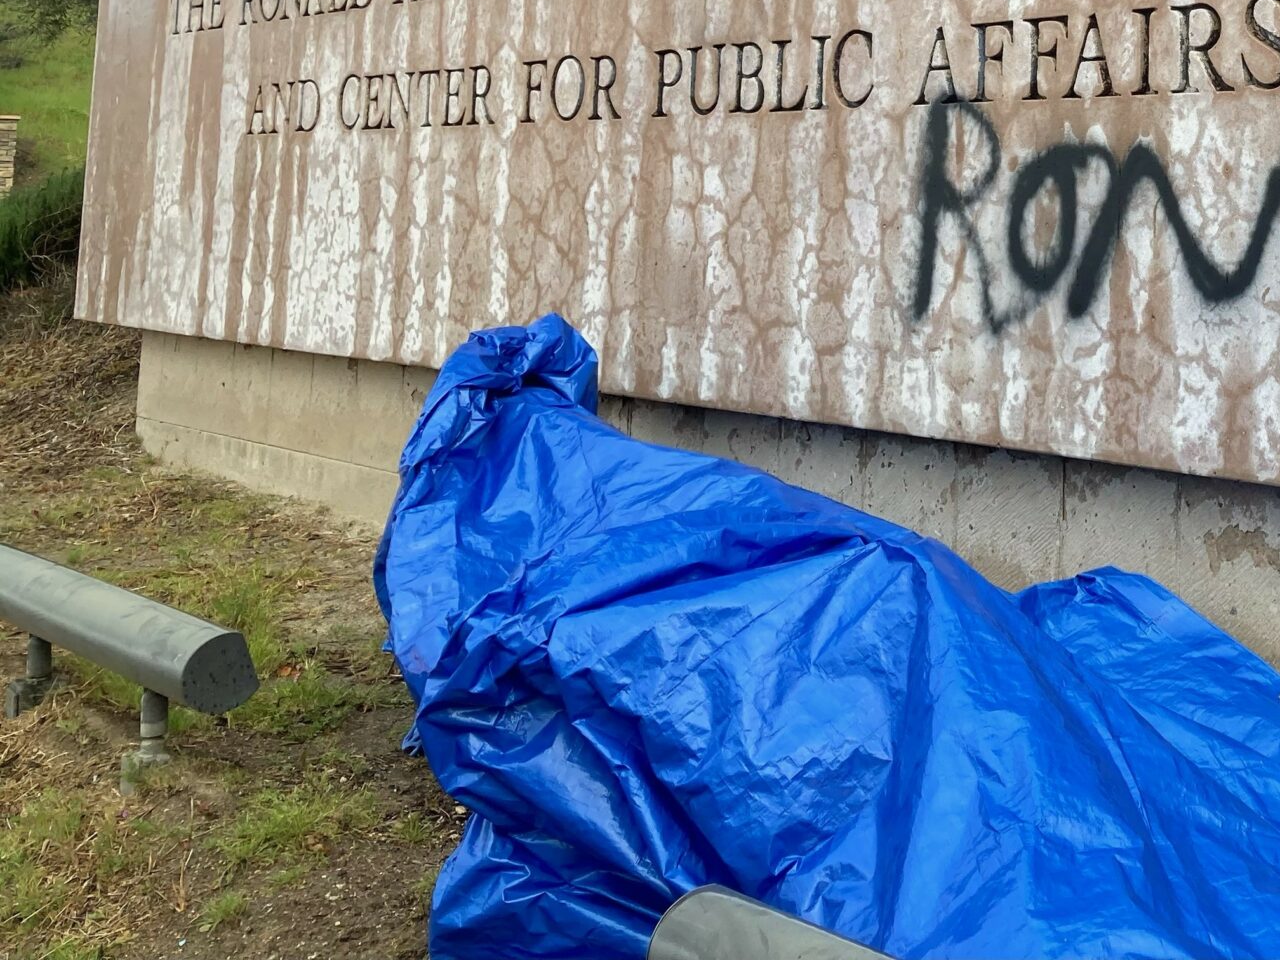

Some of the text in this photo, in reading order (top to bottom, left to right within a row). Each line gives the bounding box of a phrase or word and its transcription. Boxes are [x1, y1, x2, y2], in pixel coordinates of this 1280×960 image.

[247, 78, 322, 135] AND
[339, 64, 495, 131] CENTER
[520, 54, 621, 123] FOR
[651, 29, 875, 118] PUBLIC
